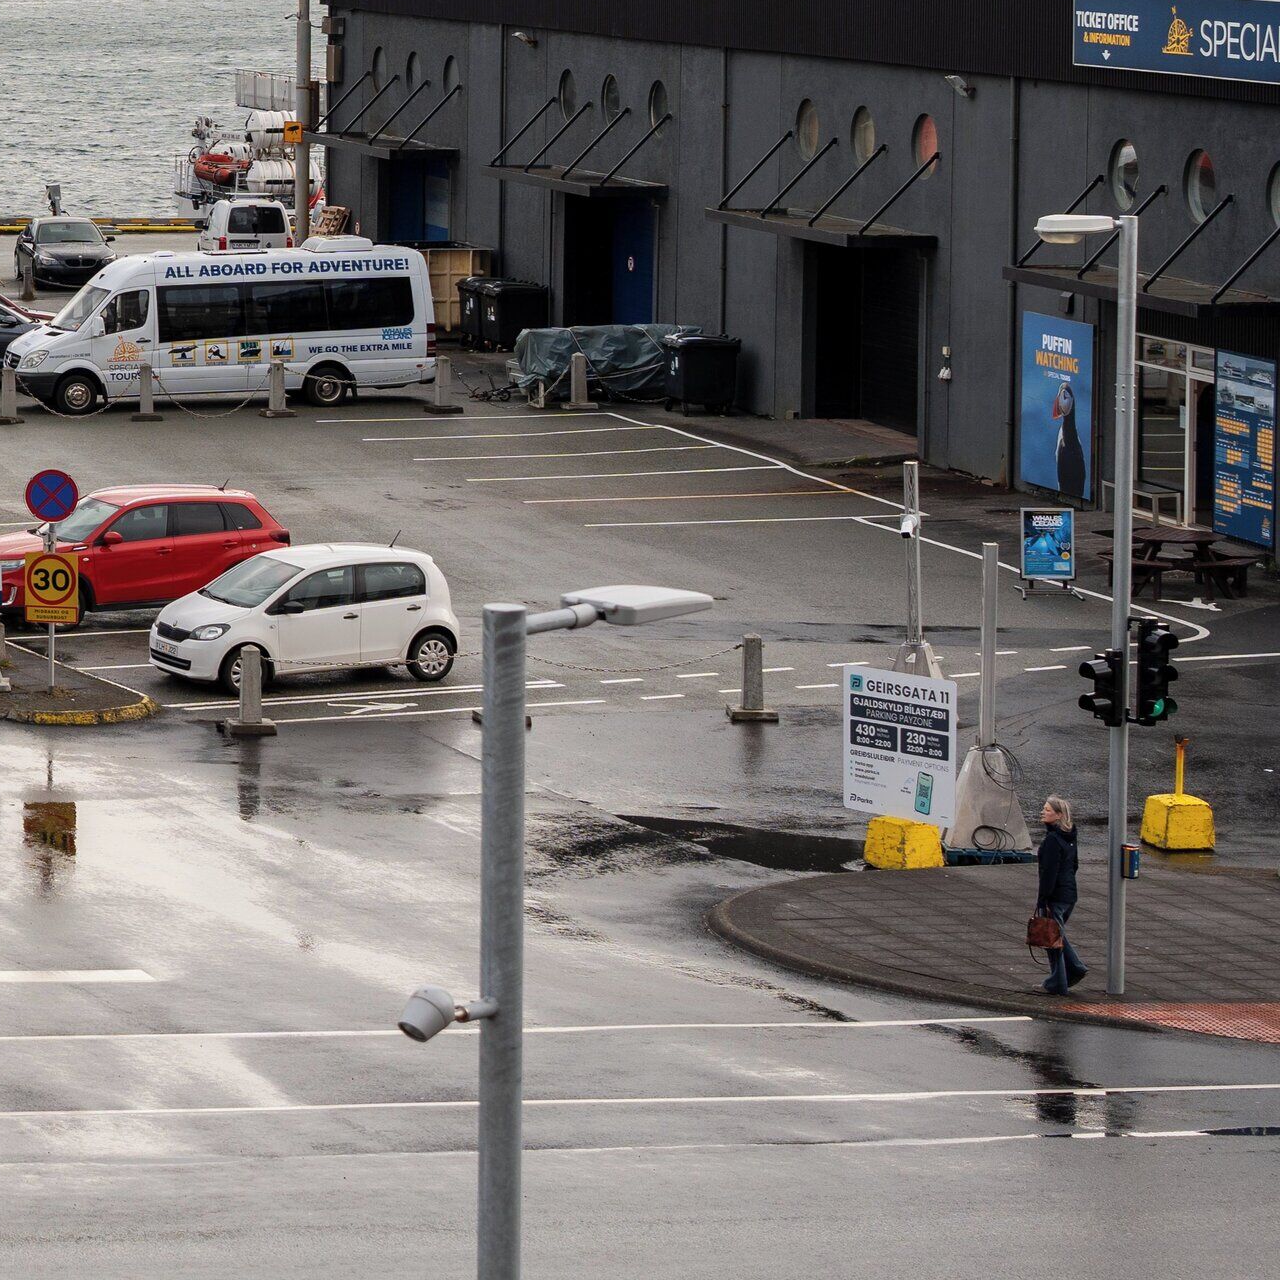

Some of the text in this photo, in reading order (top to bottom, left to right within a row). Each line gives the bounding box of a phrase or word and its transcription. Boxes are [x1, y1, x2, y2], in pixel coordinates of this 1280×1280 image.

[1076, 10, 1139, 32] TICKET OFFICE
[1083, 32, 1131, 46] & INFORMATION
[165, 258, 410, 279] ALL ABOARD FOR ADVENTURE!
[342, 345, 357, 353] THE
[360, 343, 389, 351] EXTRA
[391, 342, 413, 351] MILE
[1042, 334, 1072, 355] PUFFIN
[1036, 350, 1079, 374] WATCHING
[33, 568, 70, 592] 30
[866, 680, 949, 704] GEIRSGATA 11
[853, 697, 947, 720] GJALDSKYLD BÍLASTÆÐI
[866, 708, 933, 728] PARKING PAYZONE
[855, 723, 876, 737] 430
[906, 732, 926, 746] 230
[856, 737, 870, 745] 8:00
[874, 740, 891, 749] 22:00
[906, 744, 924, 754] 22:00
[857, 796, 873, 805] Parka
